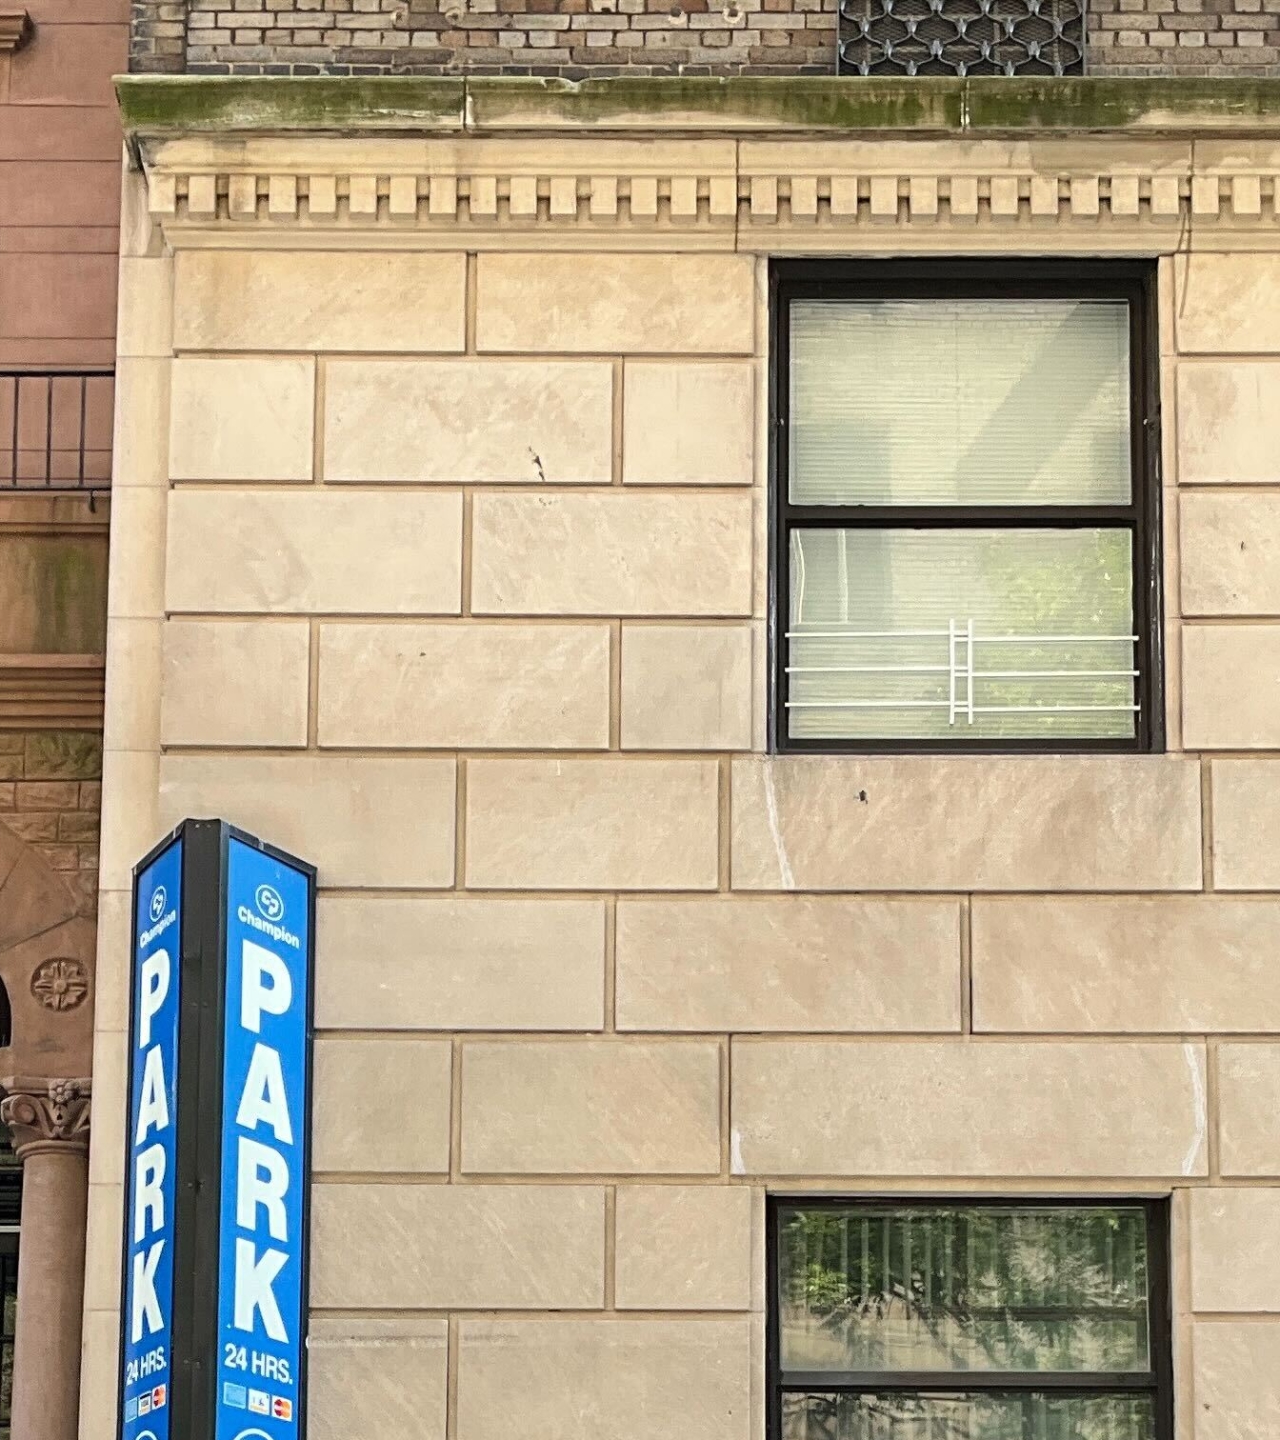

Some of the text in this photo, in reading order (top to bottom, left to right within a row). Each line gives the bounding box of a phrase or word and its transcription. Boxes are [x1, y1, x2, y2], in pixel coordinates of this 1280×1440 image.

[237, 905, 300, 949] Champion
[129, 947, 171, 1345] PARK
[233, 937, 294, 1345] PARK
[126, 1346, 167, 1387] 24 HRS.
[224, 1342, 293, 1385] 24 HRS.
